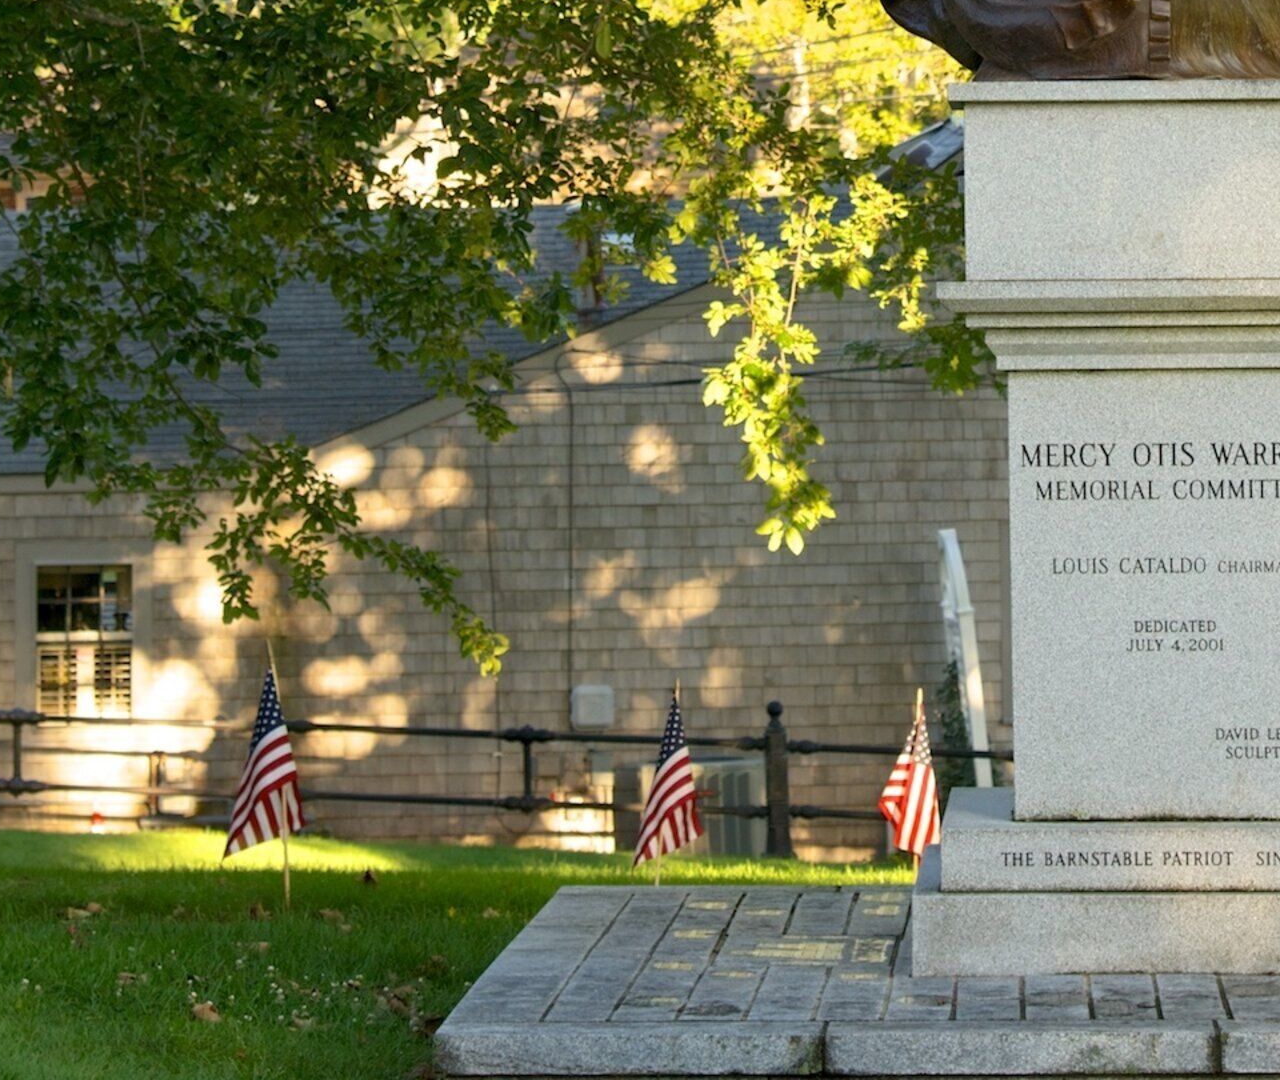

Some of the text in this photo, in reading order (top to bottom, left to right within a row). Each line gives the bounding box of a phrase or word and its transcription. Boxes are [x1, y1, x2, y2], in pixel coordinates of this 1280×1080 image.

[1021, 442, 1117, 468] MERCY
[1132, 442, 1196, 467] OTIS
[1035, 480, 1161, 501] MEMORIAL
[1052, 557, 1109, 575] LOUIS
[1119, 557, 1207, 574] CATALDO
[1134, 620, 1217, 633] DEDICATED
[1126, 639, 1163, 652] JULY
[1191, 638, 1225, 652] 2001
[1215, 727, 1260, 741] DAVID
[1001, 851, 1035, 868] THE
[1043, 851, 1154, 867] BARNSTABLE
[1163, 851, 1234, 867] PATRIOT
